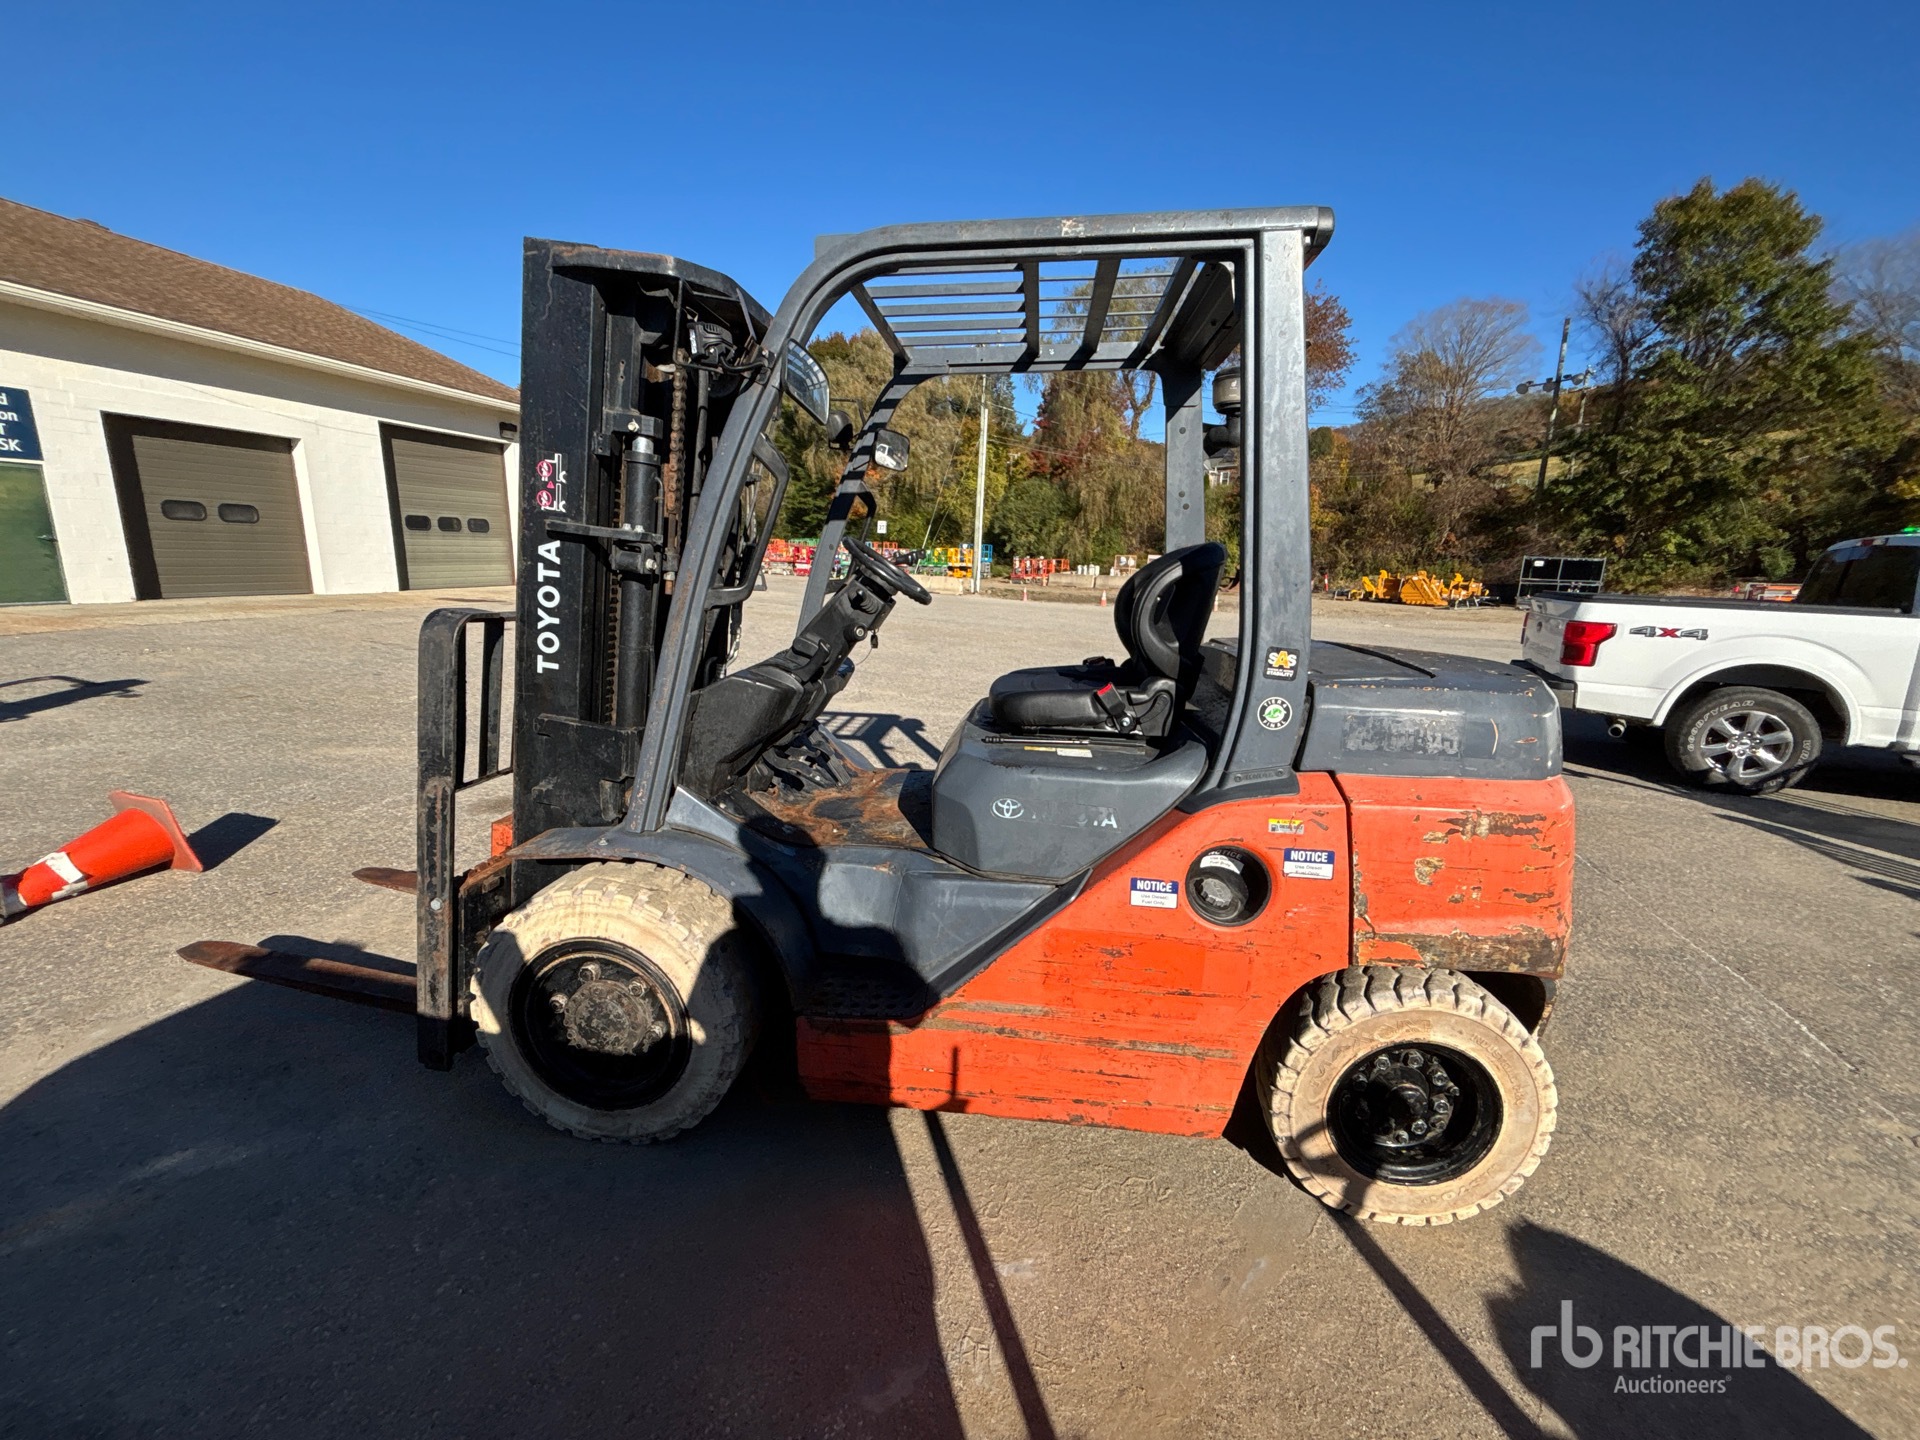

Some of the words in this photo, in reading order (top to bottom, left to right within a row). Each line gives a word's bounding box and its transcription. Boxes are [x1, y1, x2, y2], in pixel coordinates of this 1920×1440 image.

[537, 540, 561, 674] TOYOTA
[1268, 651, 1297, 668] SAS
[1687, 700, 1755, 752] GOODYEAR
[1290, 850, 1329, 863] NOTICE
[1136, 880, 1173, 892] NOTICE
